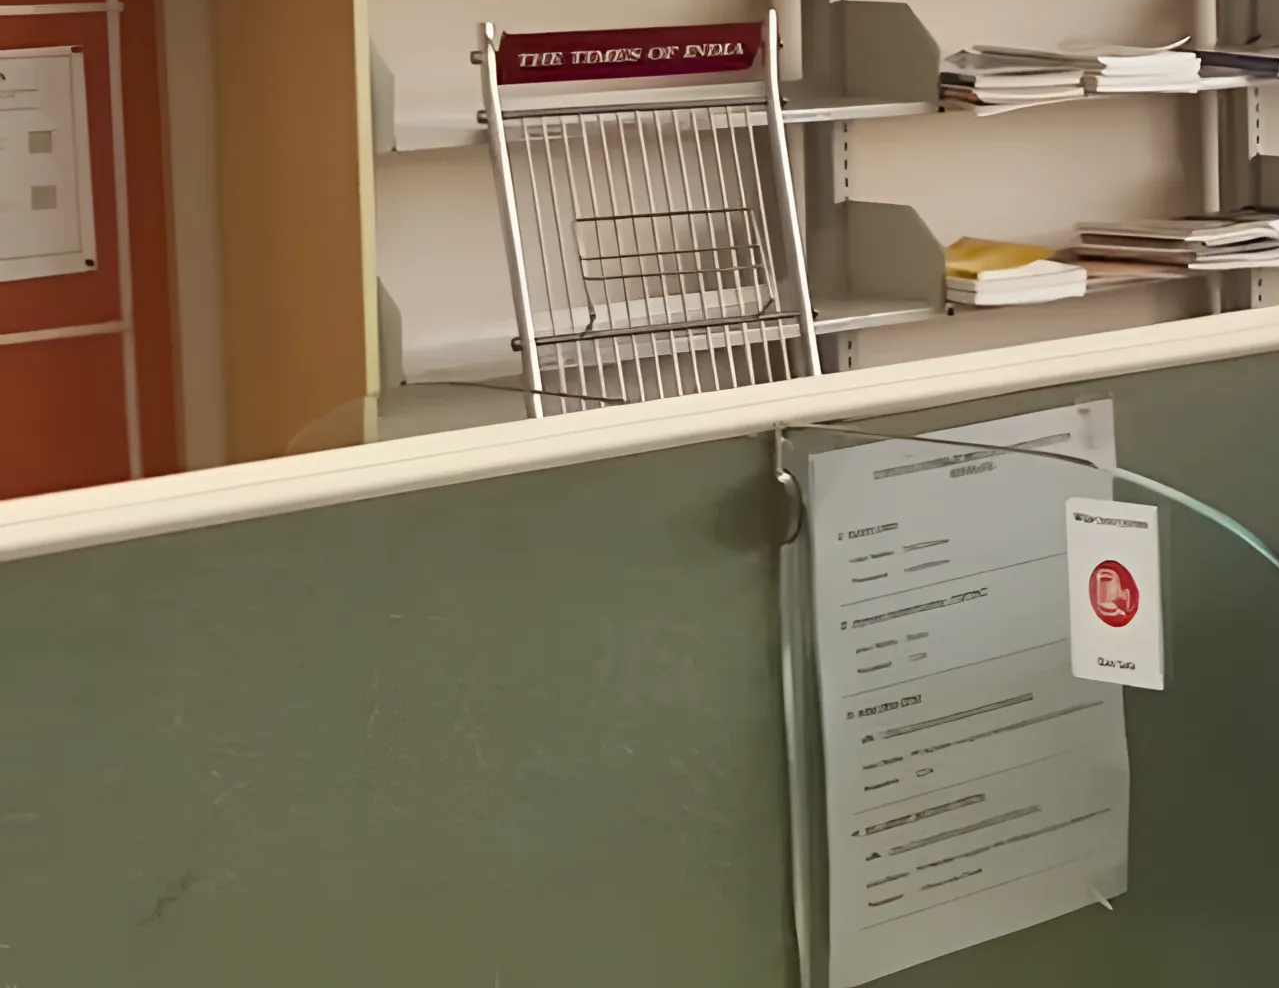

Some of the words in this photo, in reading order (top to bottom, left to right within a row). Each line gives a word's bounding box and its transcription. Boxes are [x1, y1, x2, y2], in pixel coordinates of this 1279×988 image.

[519, 51, 564, 67] THE
[571, 47, 642, 64] TIMES
[648, 45, 679, 60] OF
[683, 42, 745, 59] INDIA
